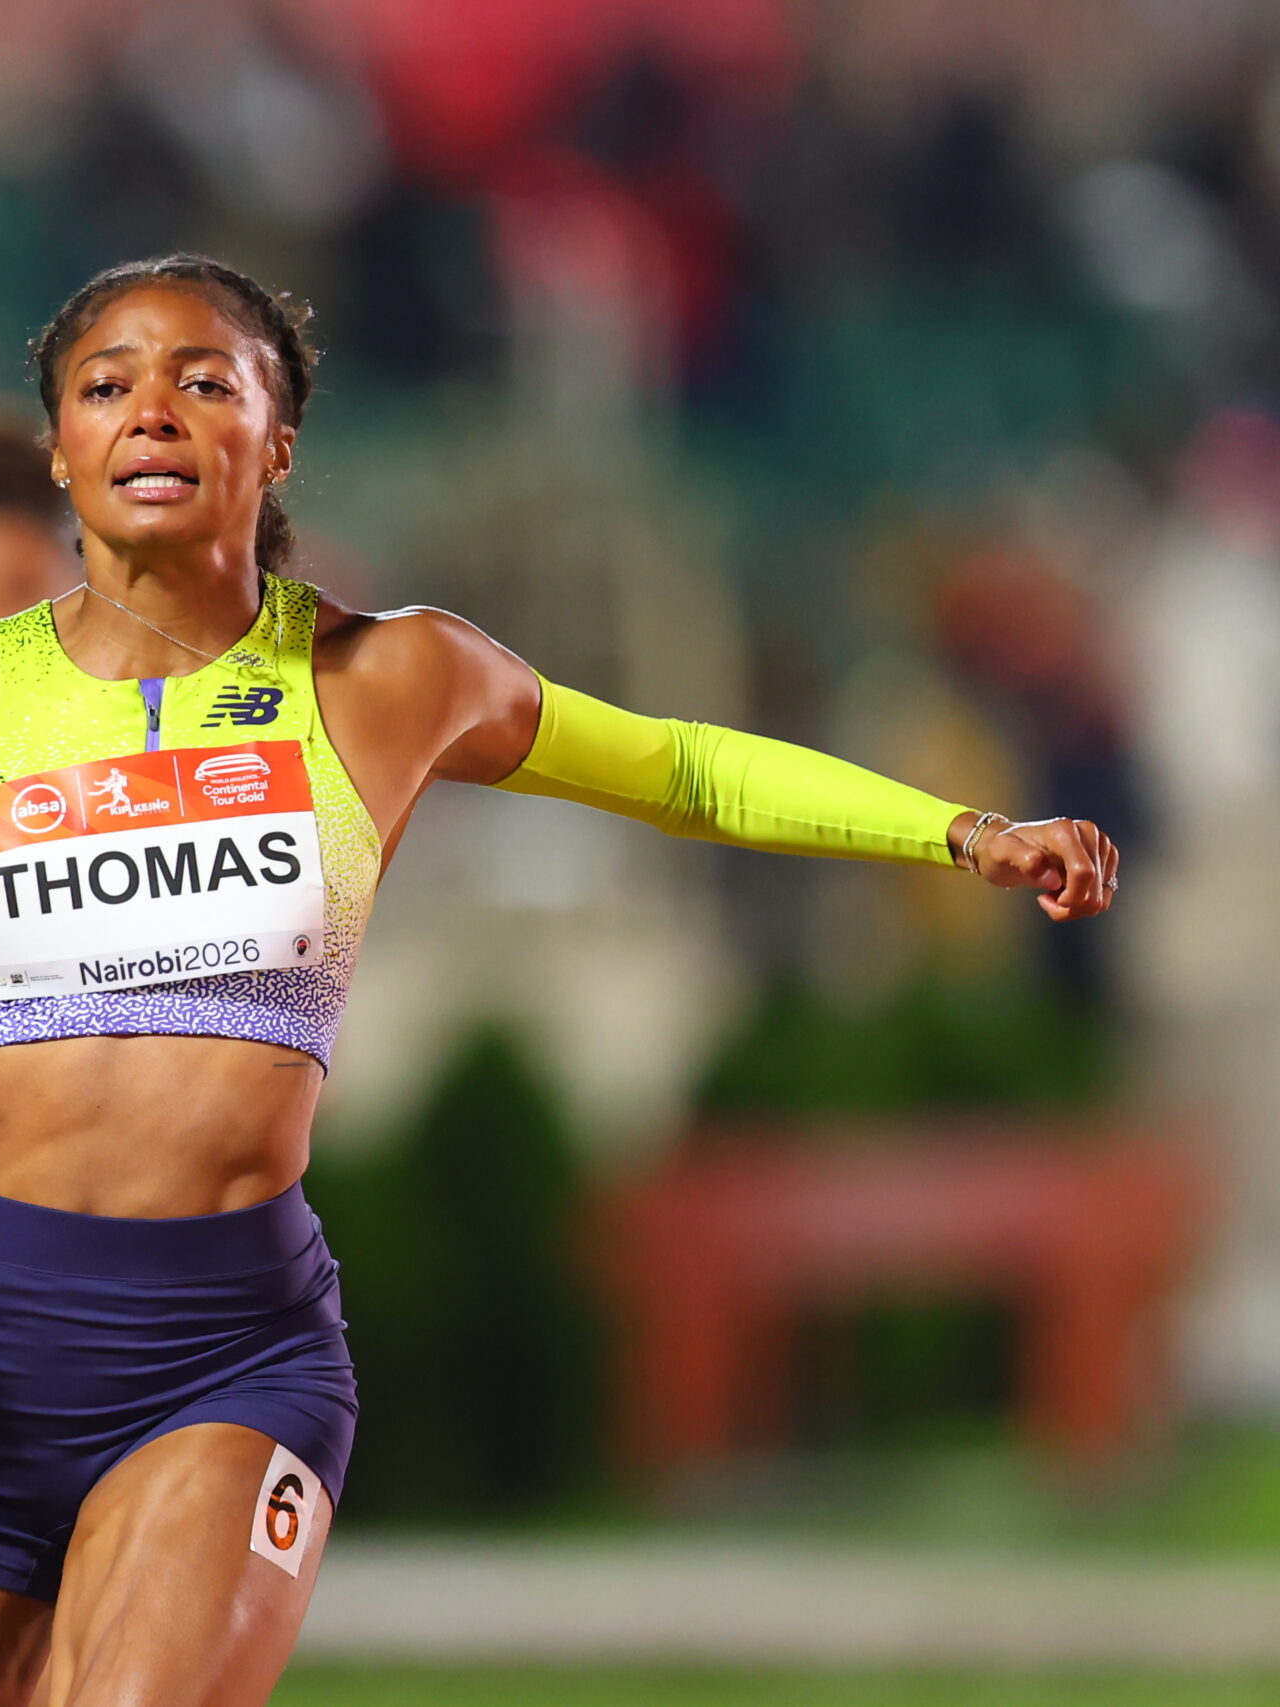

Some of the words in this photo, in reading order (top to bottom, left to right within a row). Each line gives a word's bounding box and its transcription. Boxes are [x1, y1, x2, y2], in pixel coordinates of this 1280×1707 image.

[202, 780, 269, 796] Continental
[210, 796, 235, 806] Tour
[237, 791, 265, 803] Gold
[18, 800, 61, 818] absa
[79, 938, 260, 986] Nairobi2026
[266, 1473, 304, 1551] 6
